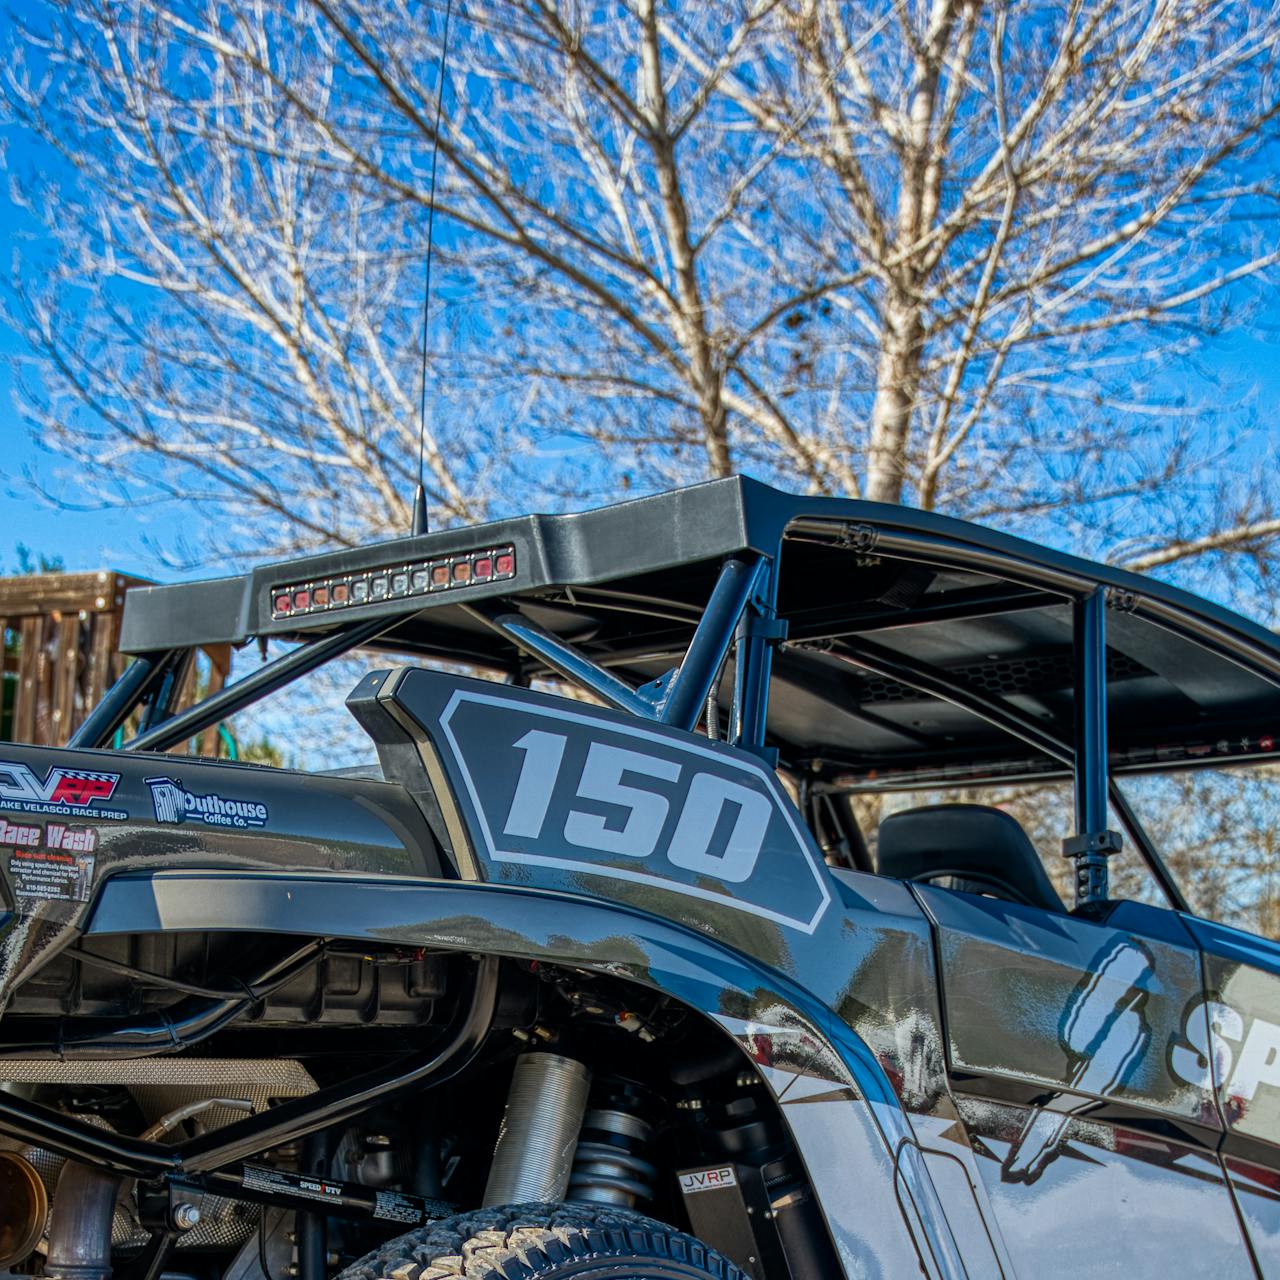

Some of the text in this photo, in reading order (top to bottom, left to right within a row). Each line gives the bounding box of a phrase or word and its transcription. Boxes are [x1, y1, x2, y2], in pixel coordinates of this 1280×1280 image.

[22, 802, 70, 815] VELASCO
[72, 808, 99, 818] RACE
[101, 810, 128, 820] PREP
[502, 729, 774, 884] 150
[203, 812, 247, 827] Coffee Co.
[46, 824, 96, 851] Wash
[684, 1169, 731, 1188] JVRP
